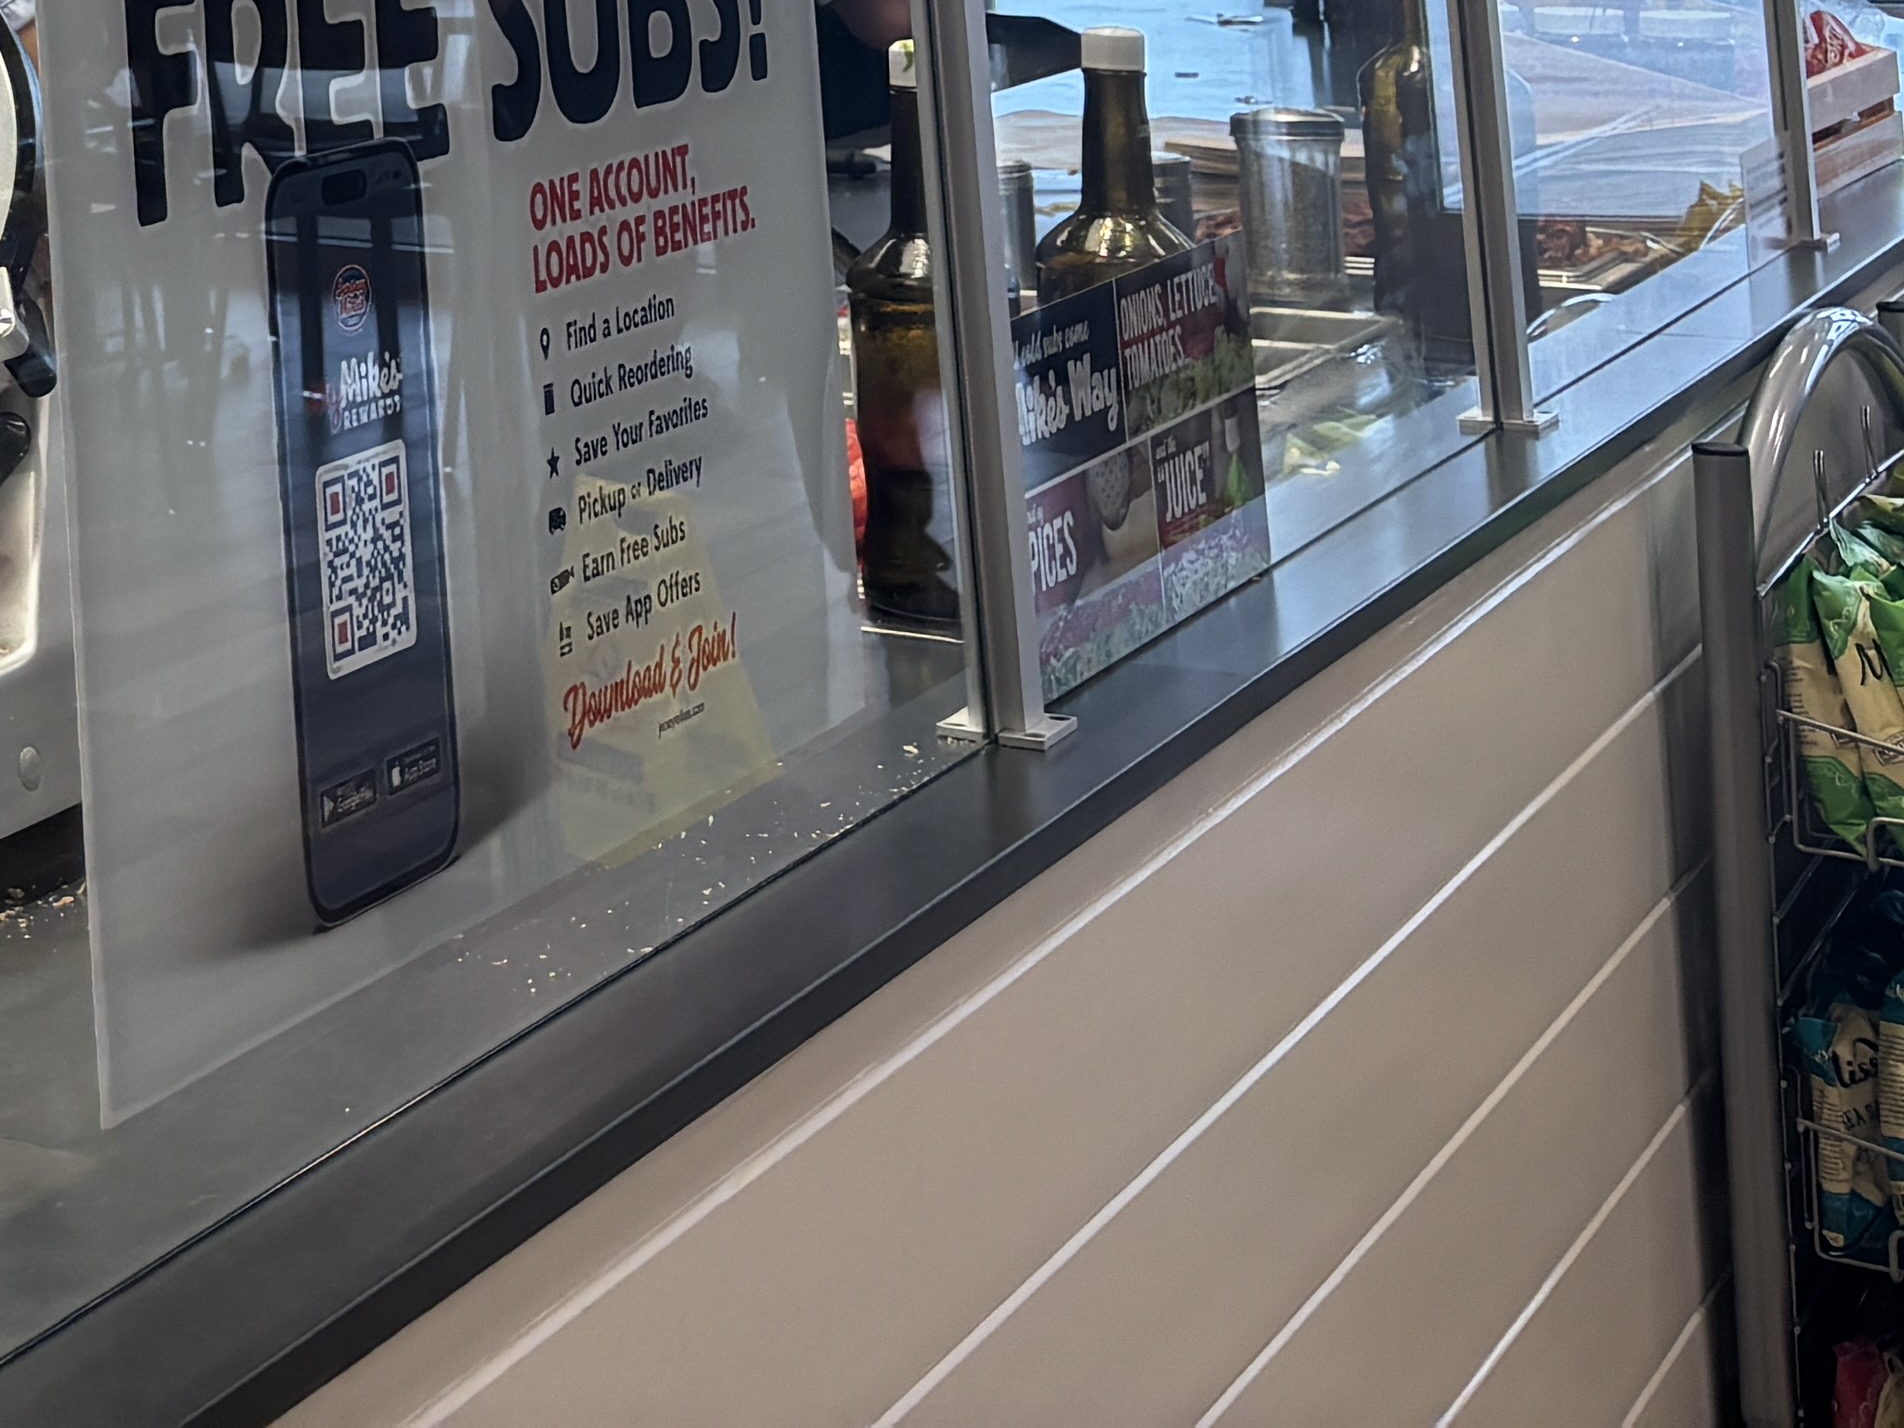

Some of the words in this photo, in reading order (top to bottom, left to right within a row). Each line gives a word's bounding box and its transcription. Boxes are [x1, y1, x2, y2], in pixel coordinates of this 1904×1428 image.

[529, 172, 581, 231] ONE
[589, 143, 695, 216] ACCOUNT,
[533, 225, 610, 293] LOADS
[617, 215, 647, 267] OF
[653, 185, 756, 258] BENEFITS.
[566, 313, 596, 351] Find
[602, 316, 612, 338] a
[615, 294, 675, 335] Location
[582, 550, 615, 583] Earn
[620, 535, 649, 566] Free
[653, 517, 686, 552] Subs
[564, 650, 666, 750] Download
